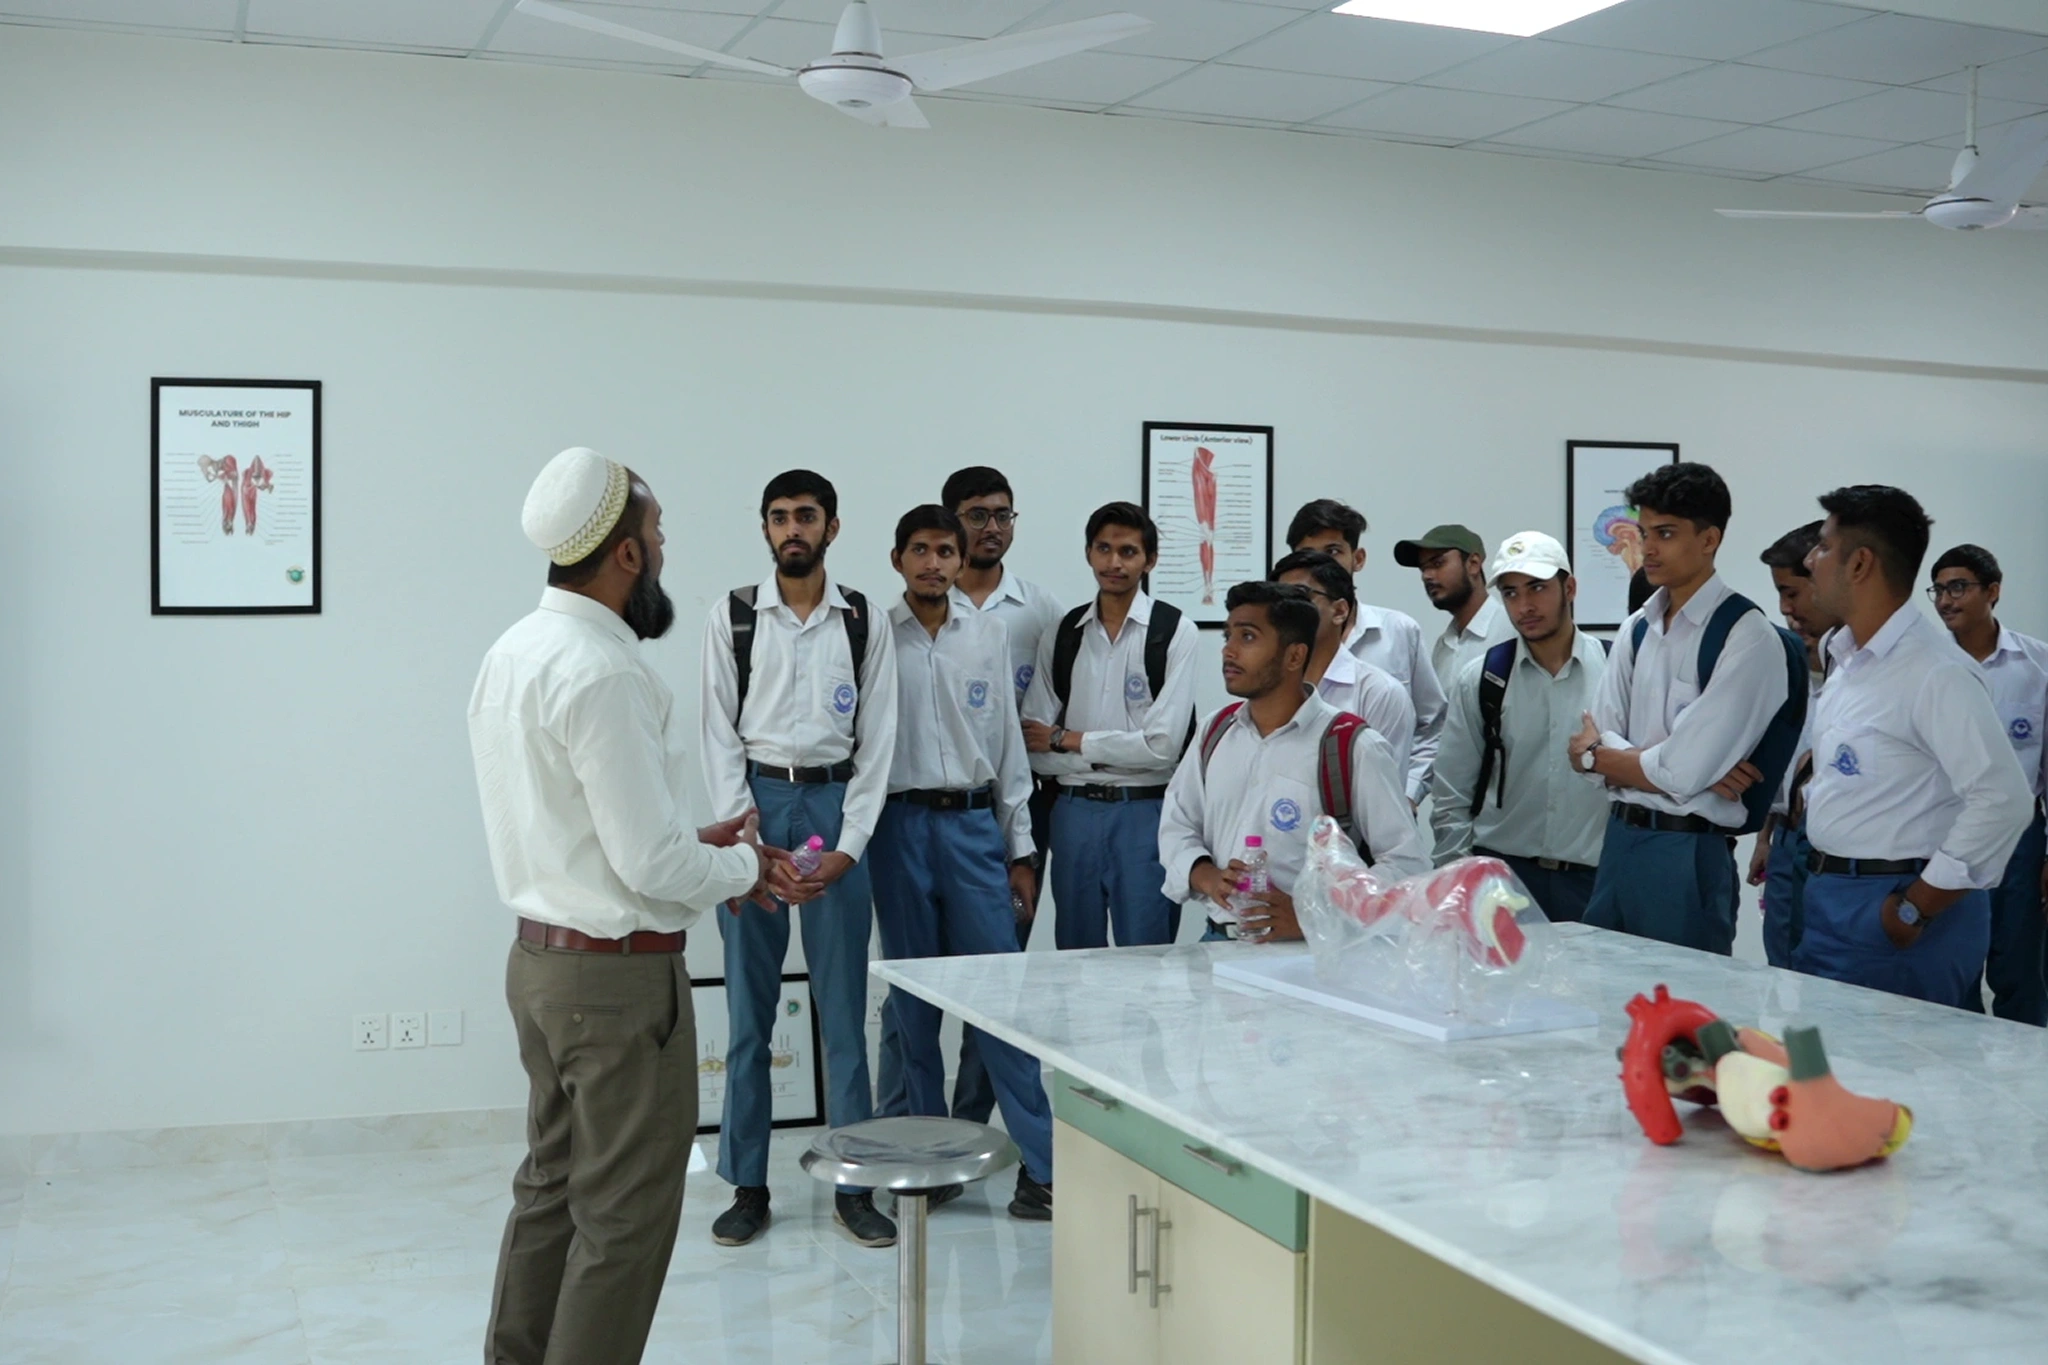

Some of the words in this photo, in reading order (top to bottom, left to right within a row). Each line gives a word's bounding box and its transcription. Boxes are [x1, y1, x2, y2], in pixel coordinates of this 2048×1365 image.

[179, 409, 243, 418] MUSCULATURE
[245, 410, 257, 418] OF
[259, 410, 275, 418] THE
[211, 420, 231, 428] AND
[233, 420, 260, 428] THIGH
[1182, 434, 1200, 442] Limb
[1201, 434, 1232, 443] (Anterior
